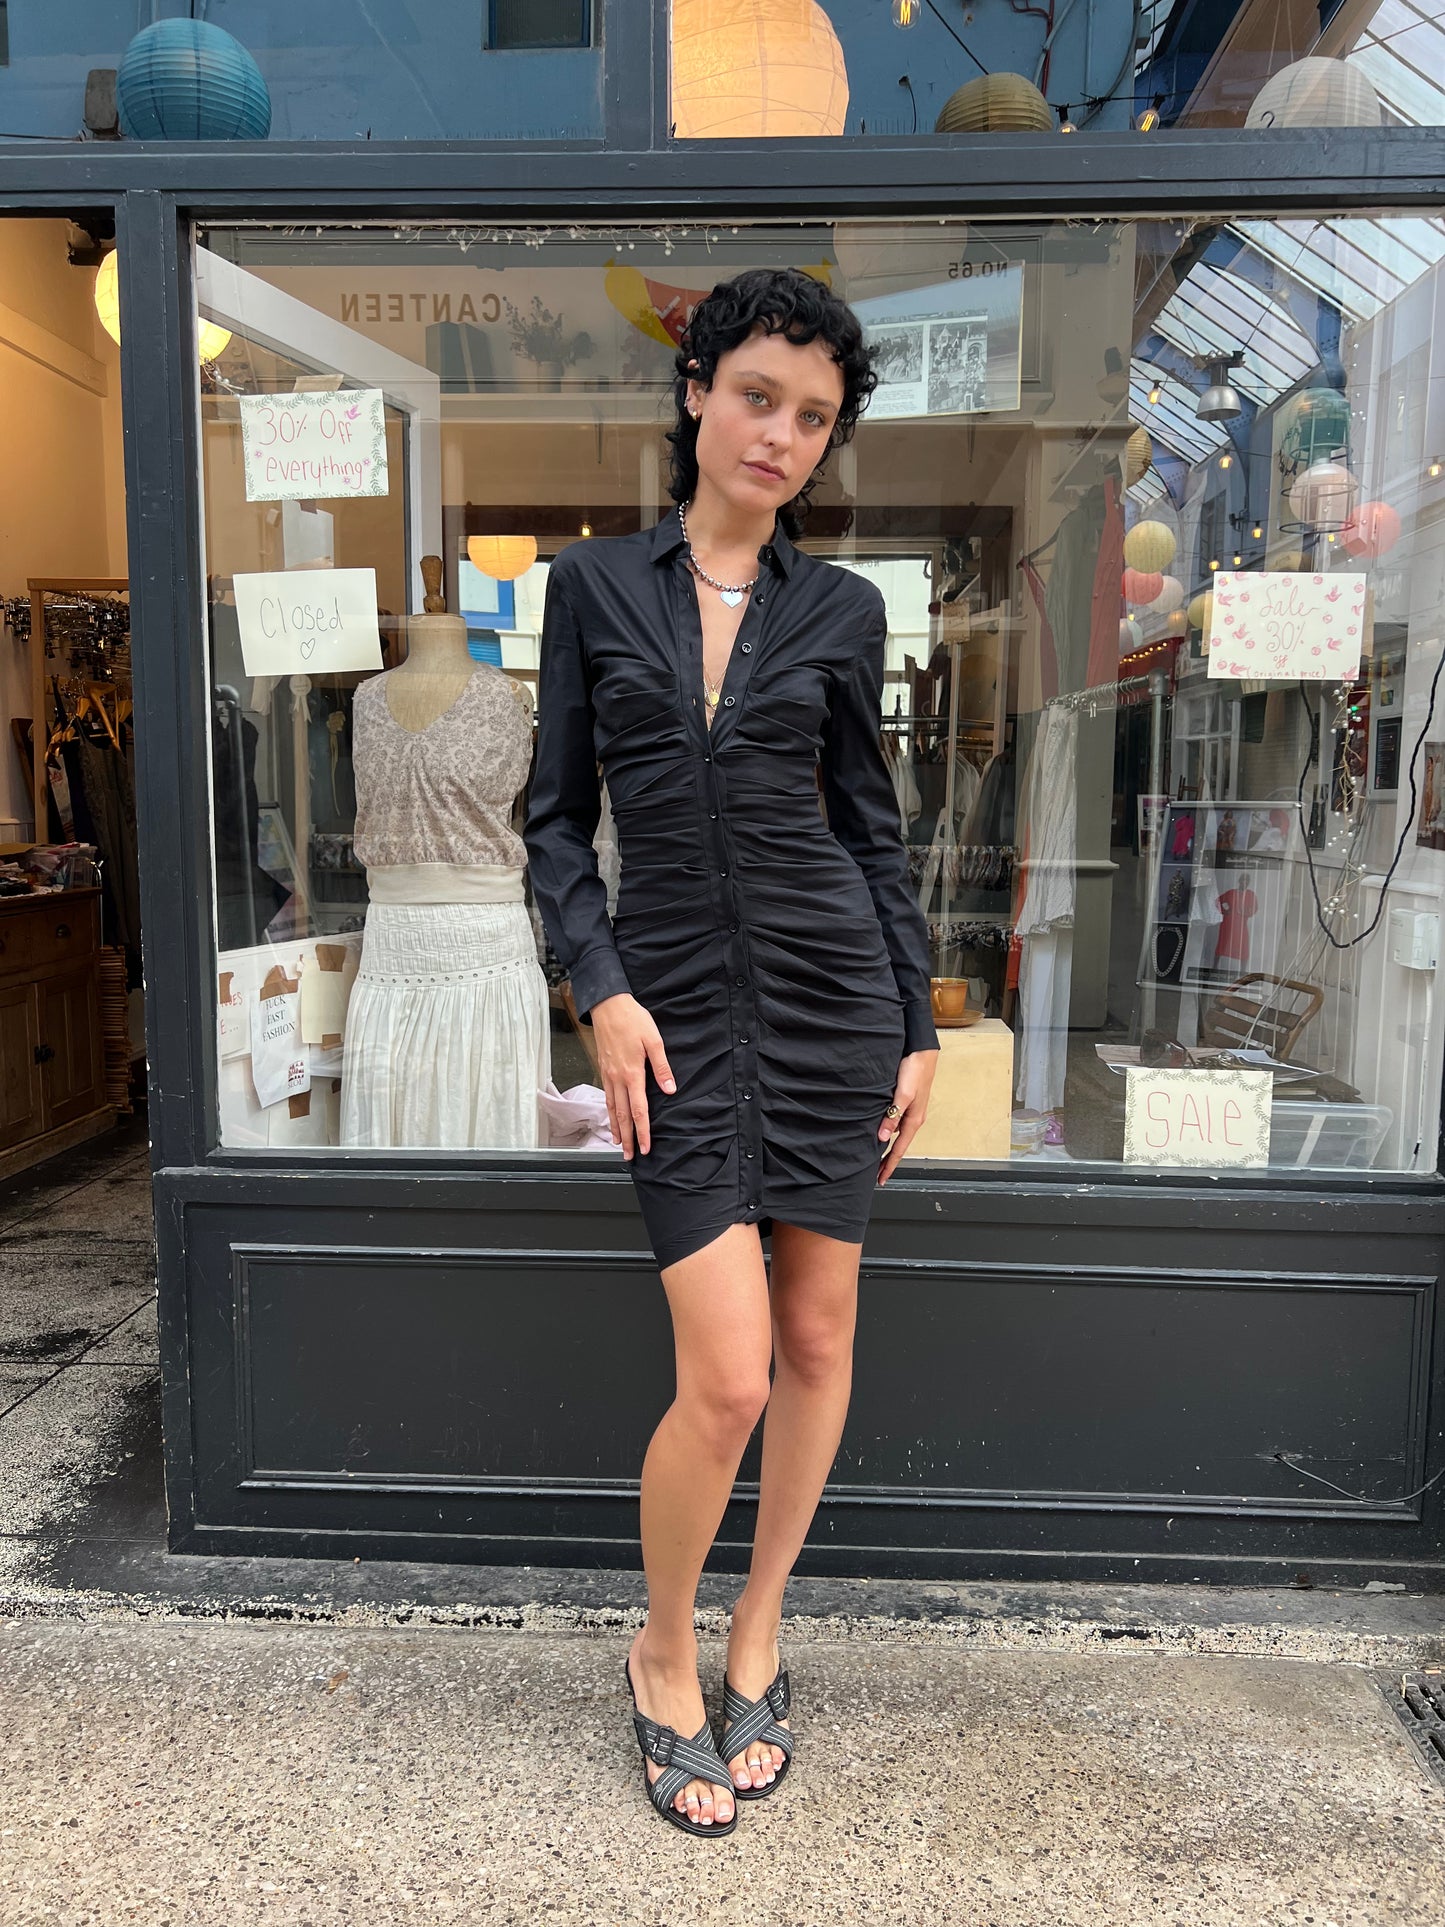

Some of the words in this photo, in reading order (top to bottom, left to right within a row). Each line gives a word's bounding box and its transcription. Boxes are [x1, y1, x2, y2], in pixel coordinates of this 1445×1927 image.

[256, 407, 308, 447] 30%
[265, 455, 364, 490] everything
[259, 596, 344, 639] Closed
[1259, 583, 1320, 618] Sale
[1265, 620, 1306, 653] 30%
[1273, 654, 1289, 669] off
[262, 1021, 296, 1042] FASHION
[267, 1010, 286, 1025] FAST
